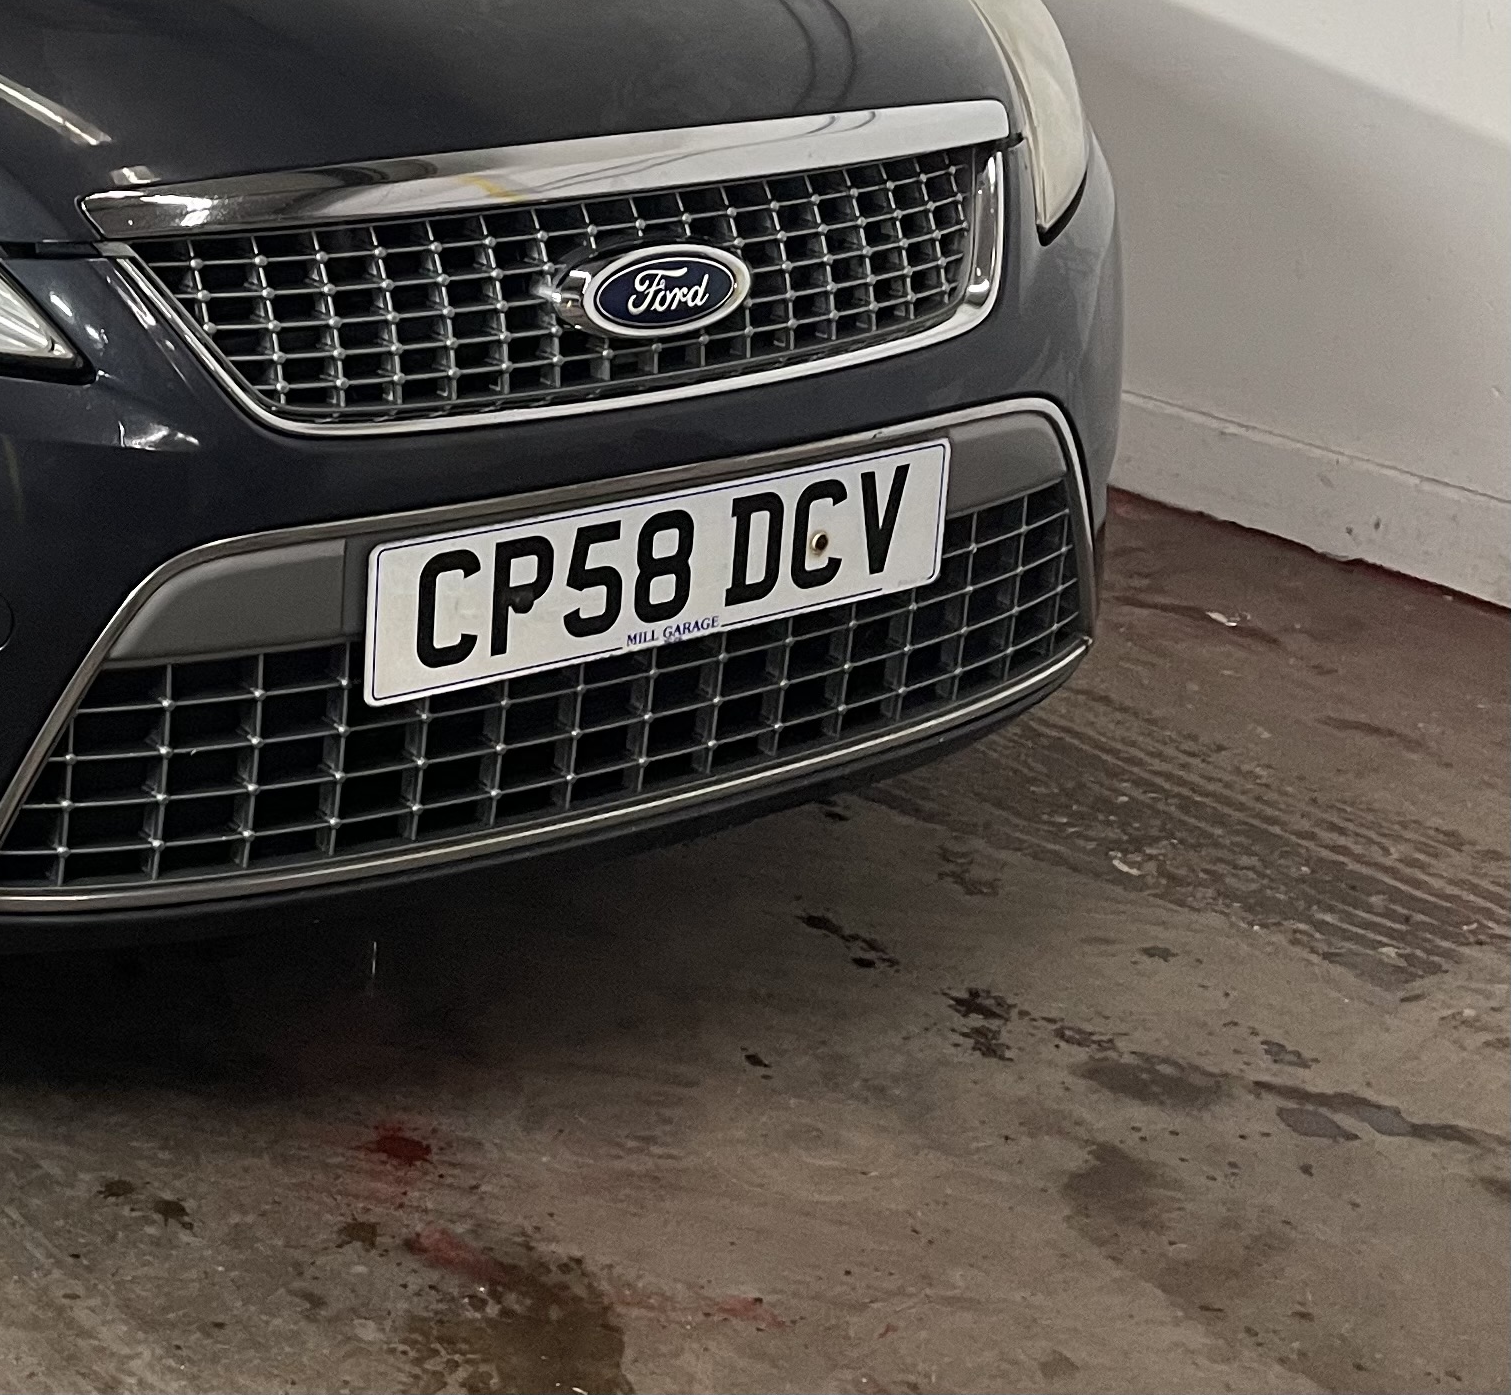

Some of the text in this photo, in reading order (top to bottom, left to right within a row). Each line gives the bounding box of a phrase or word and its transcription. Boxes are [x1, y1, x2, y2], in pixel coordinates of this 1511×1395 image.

[628, 267, 709, 315] Ford
[416, 464, 910, 669] CP58 DCV
[627, 630, 658, 646] MILL
[663, 616, 719, 639] GARAGE
